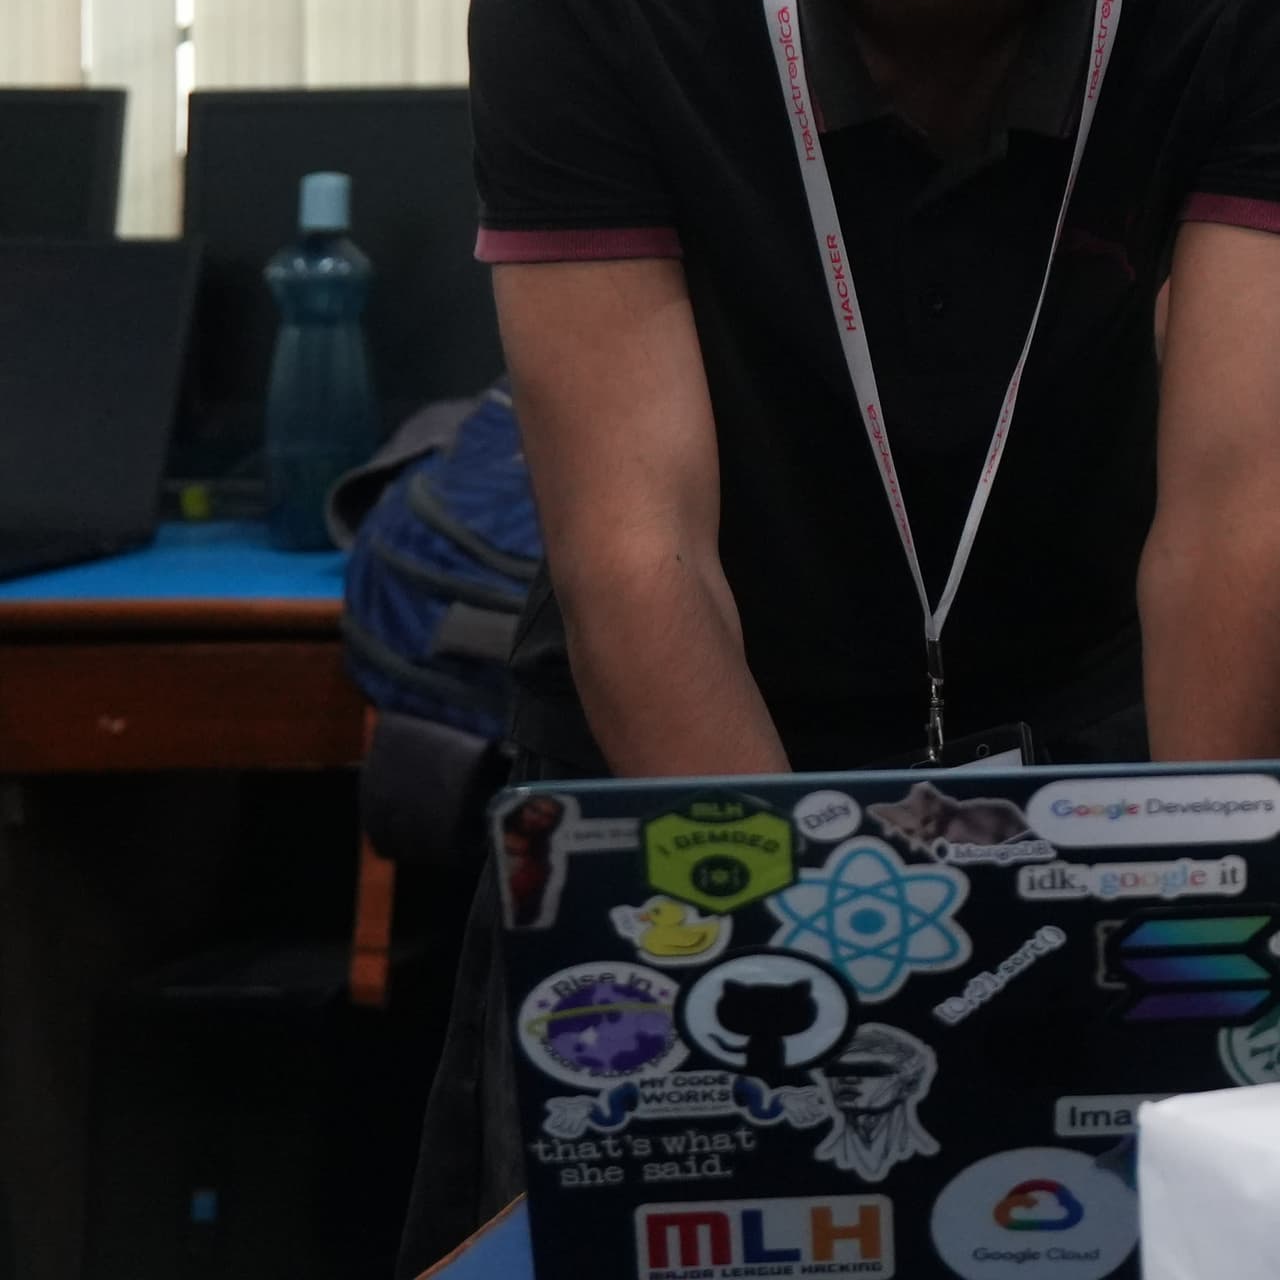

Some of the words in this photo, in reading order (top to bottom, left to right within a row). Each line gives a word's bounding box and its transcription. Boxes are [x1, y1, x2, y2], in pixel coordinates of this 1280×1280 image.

[777, 5, 816, 161] hacktropica
[827, 233, 858, 332] HACKER
[1050, 798, 1141, 821] Google
[1145, 797, 1276, 817] Developers
[1028, 867, 1088, 893] idk,
[1100, 862, 1209, 895] google
[1218, 862, 1241, 885] it
[551, 971, 618, 998] Rise
[671, 1074, 730, 1087] CODE
[639, 1089, 731, 1104] WORKS
[531, 1135, 652, 1162] that's
[660, 1127, 757, 1155] what
[560, 1163, 625, 1187] she
[642, 1154, 734, 1181] said.
[645, 1203, 882, 1270] MLH
[720, 1266, 795, 1278] LEAGUE
[801, 1261, 885, 1275] HACKING
[971, 1246, 1041, 1265] Google
[1046, 1248, 1102, 1263] Cloud
